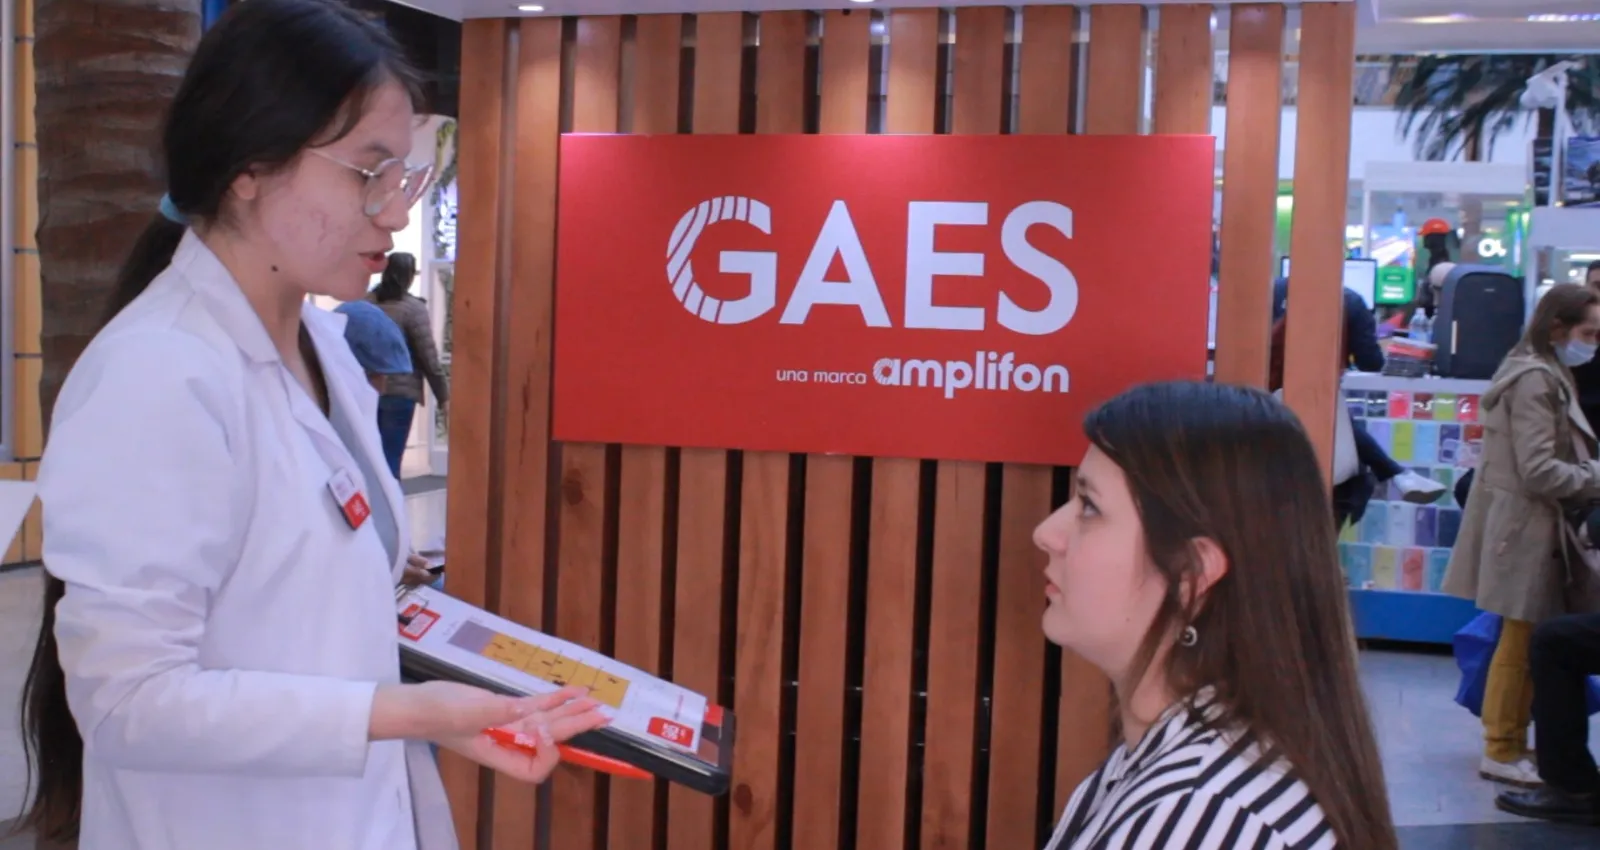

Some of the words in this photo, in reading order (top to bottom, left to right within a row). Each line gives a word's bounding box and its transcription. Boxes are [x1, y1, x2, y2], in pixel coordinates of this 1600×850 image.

[666, 195, 1079, 335] GAES
[776, 369, 808, 382] una
[814, 370, 867, 384] marca
[872, 350, 1070, 399] amplifon
